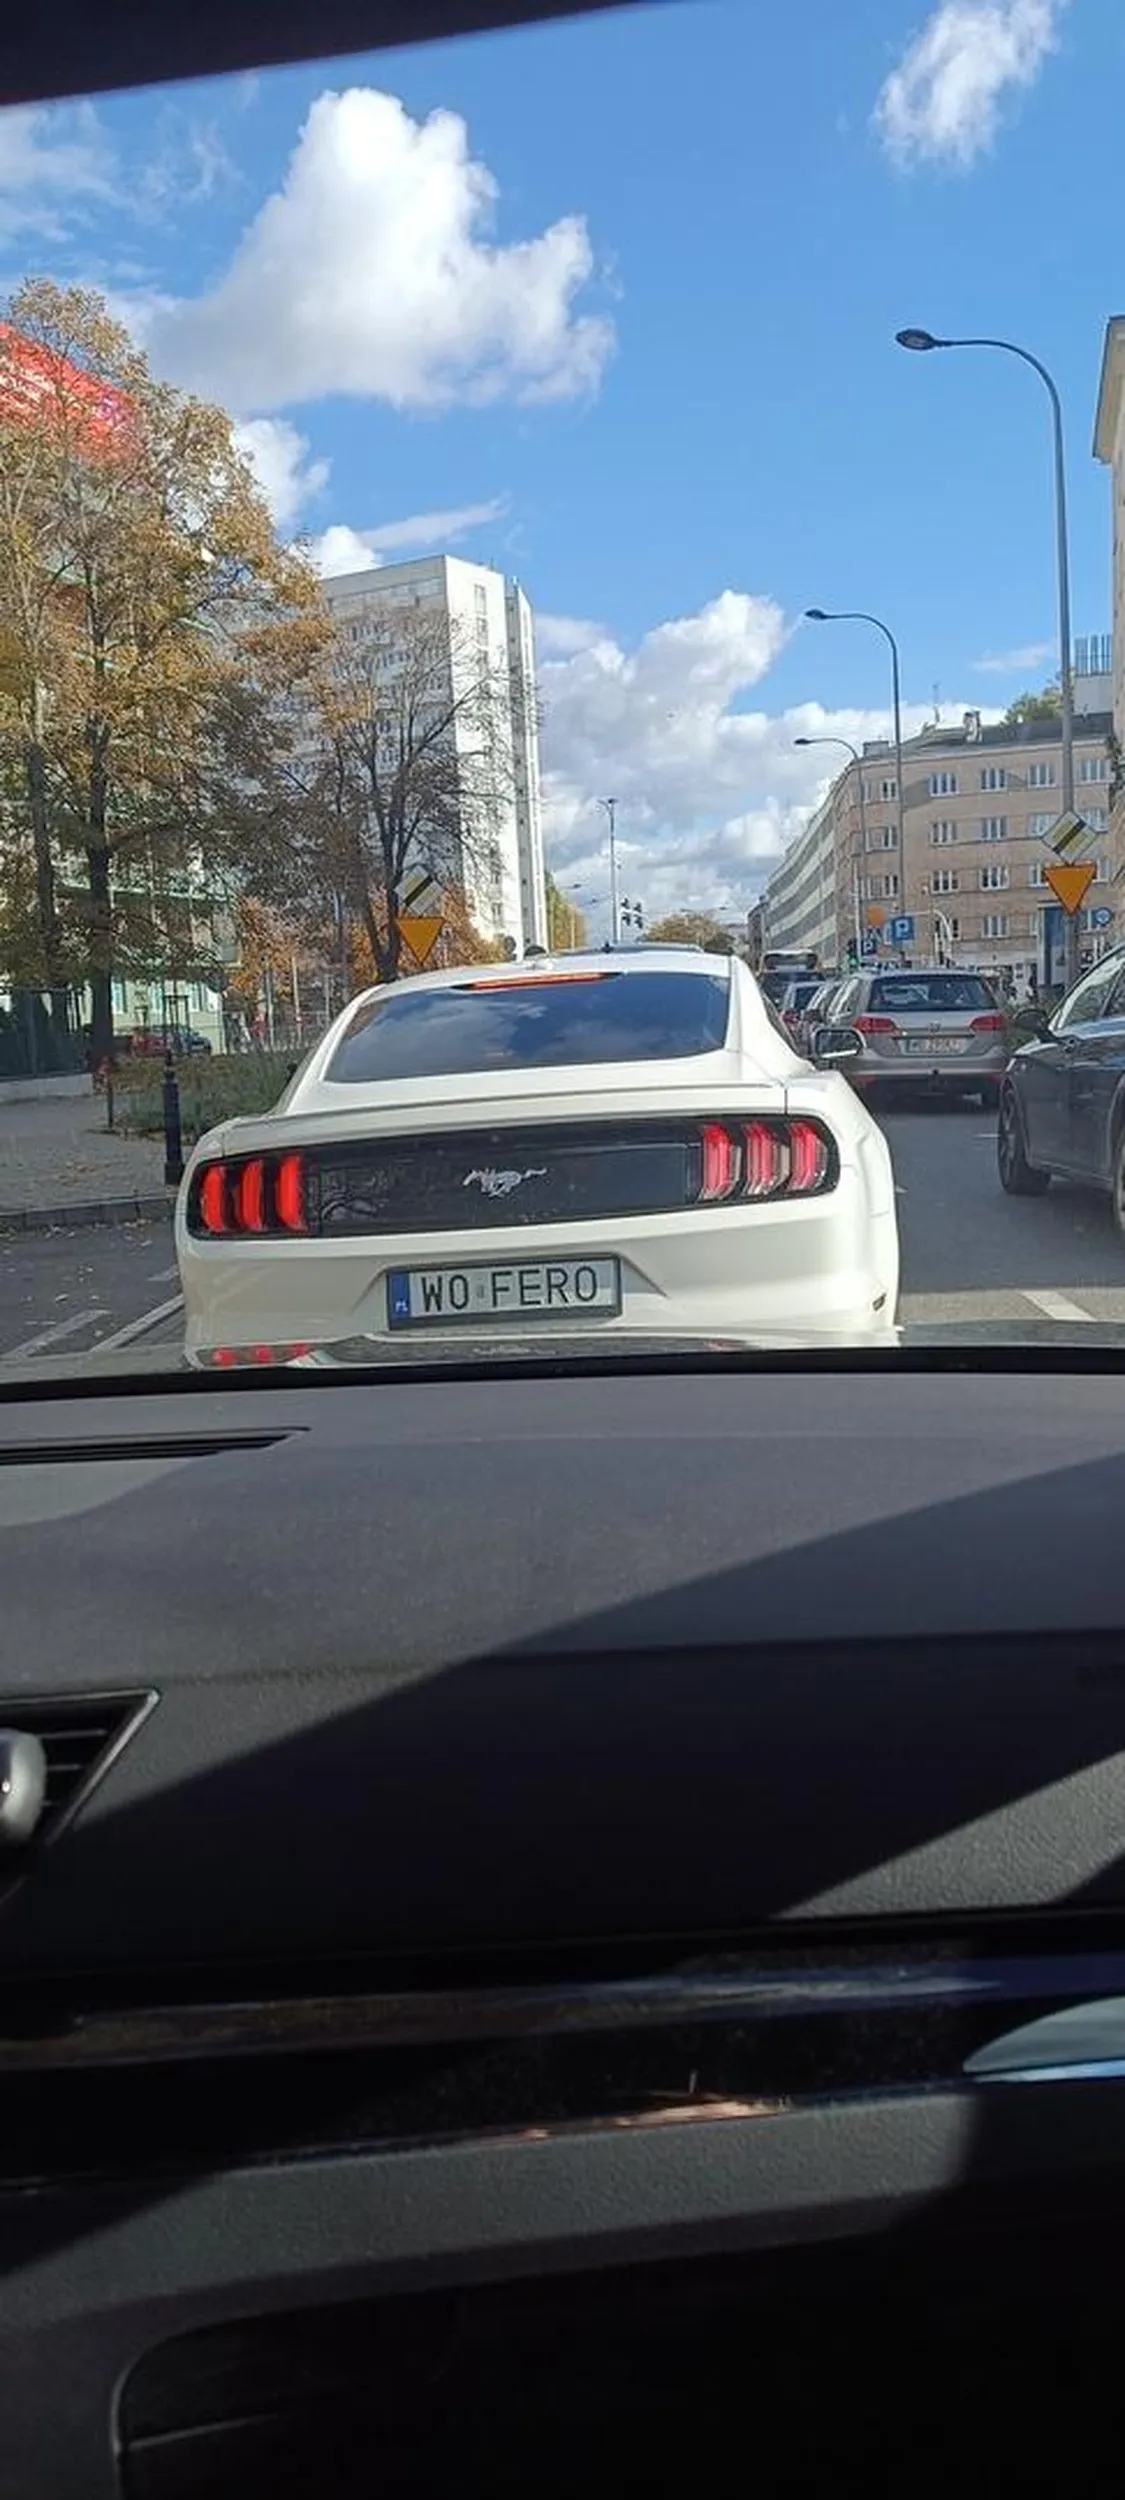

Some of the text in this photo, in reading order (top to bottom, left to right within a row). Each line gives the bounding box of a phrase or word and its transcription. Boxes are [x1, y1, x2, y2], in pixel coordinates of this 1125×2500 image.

[895, 919, 909, 938] P
[863, 940, 873, 953] P
[491, 1265, 598, 1307] FERO
